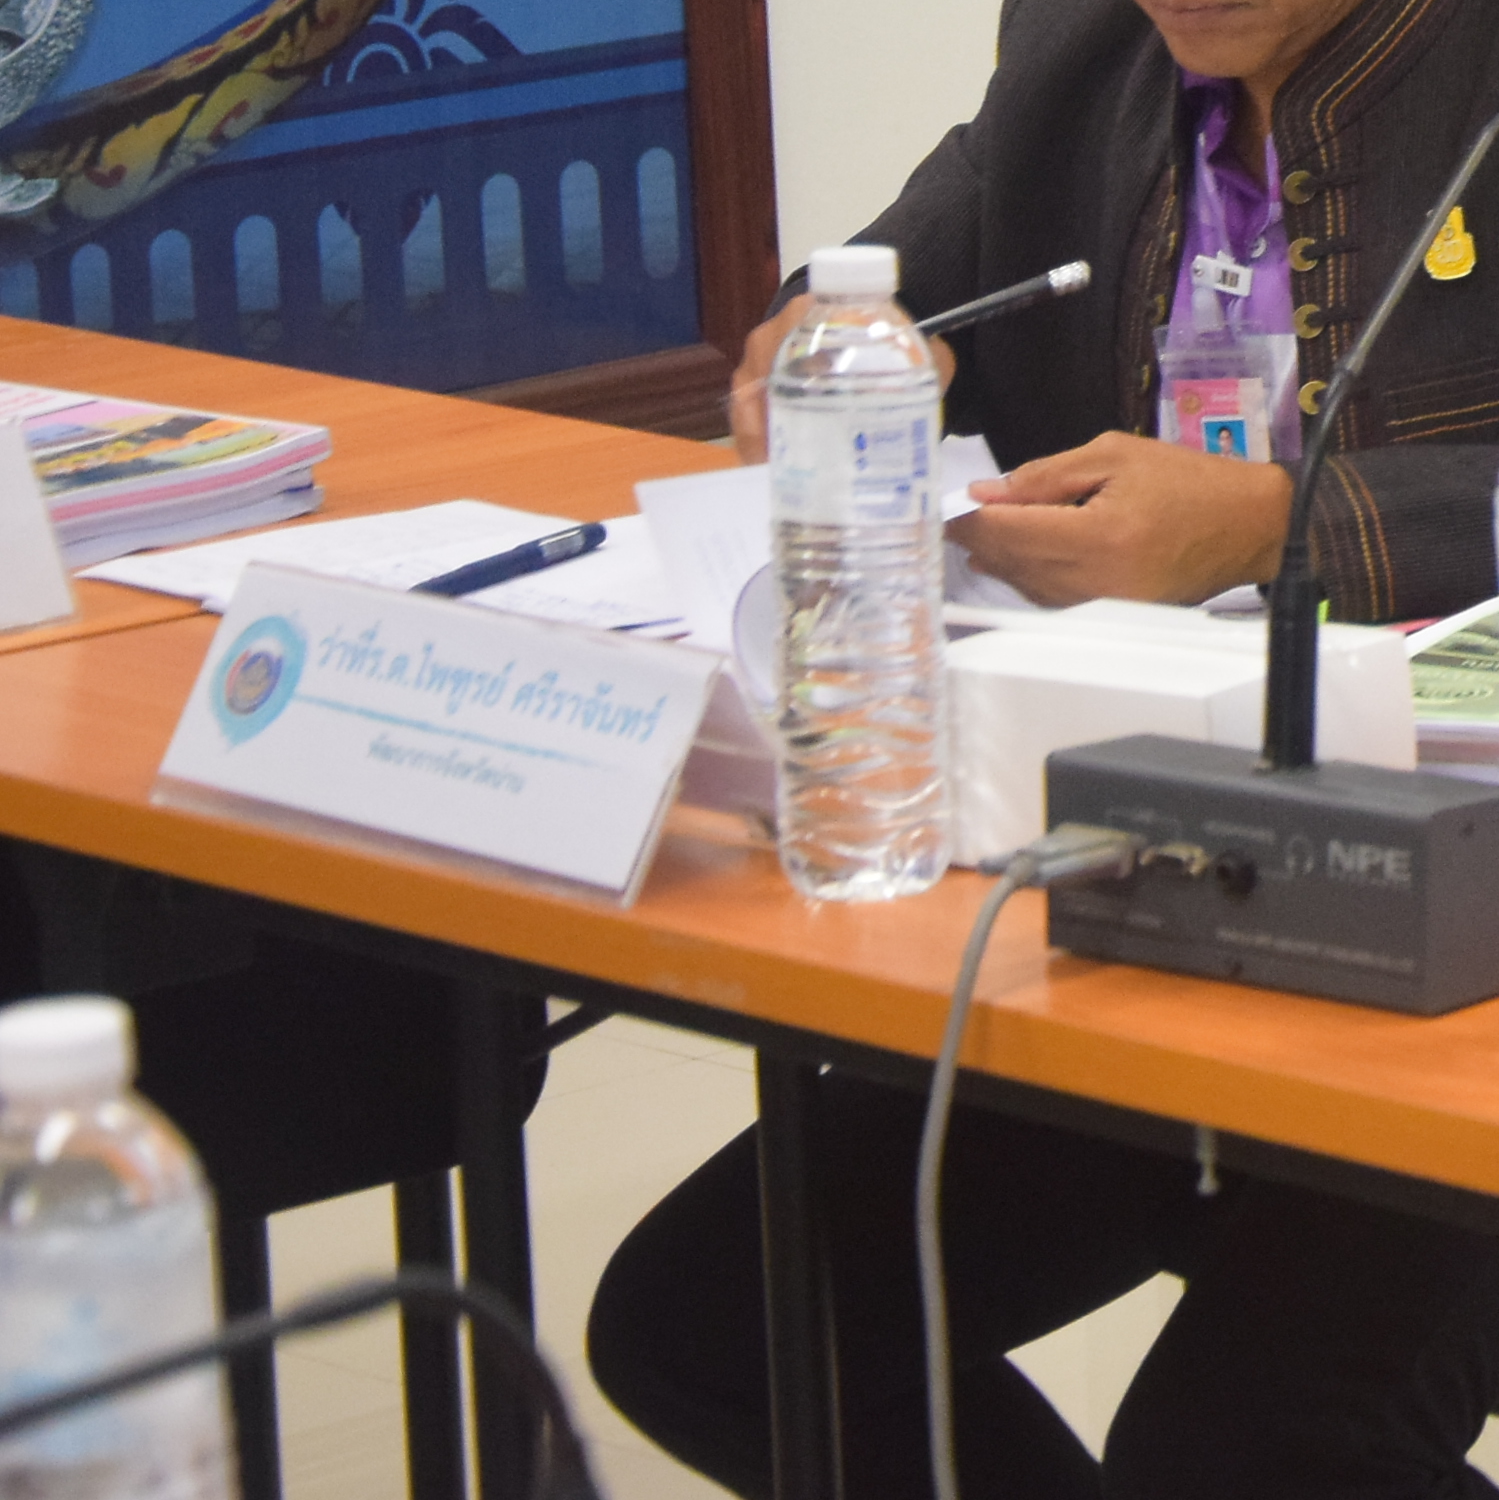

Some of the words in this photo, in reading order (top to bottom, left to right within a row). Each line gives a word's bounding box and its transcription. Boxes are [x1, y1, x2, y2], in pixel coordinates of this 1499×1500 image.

[510, 670, 669, 744] ศรีราจันทร์
[1327, 839, 1413, 883] NPE
